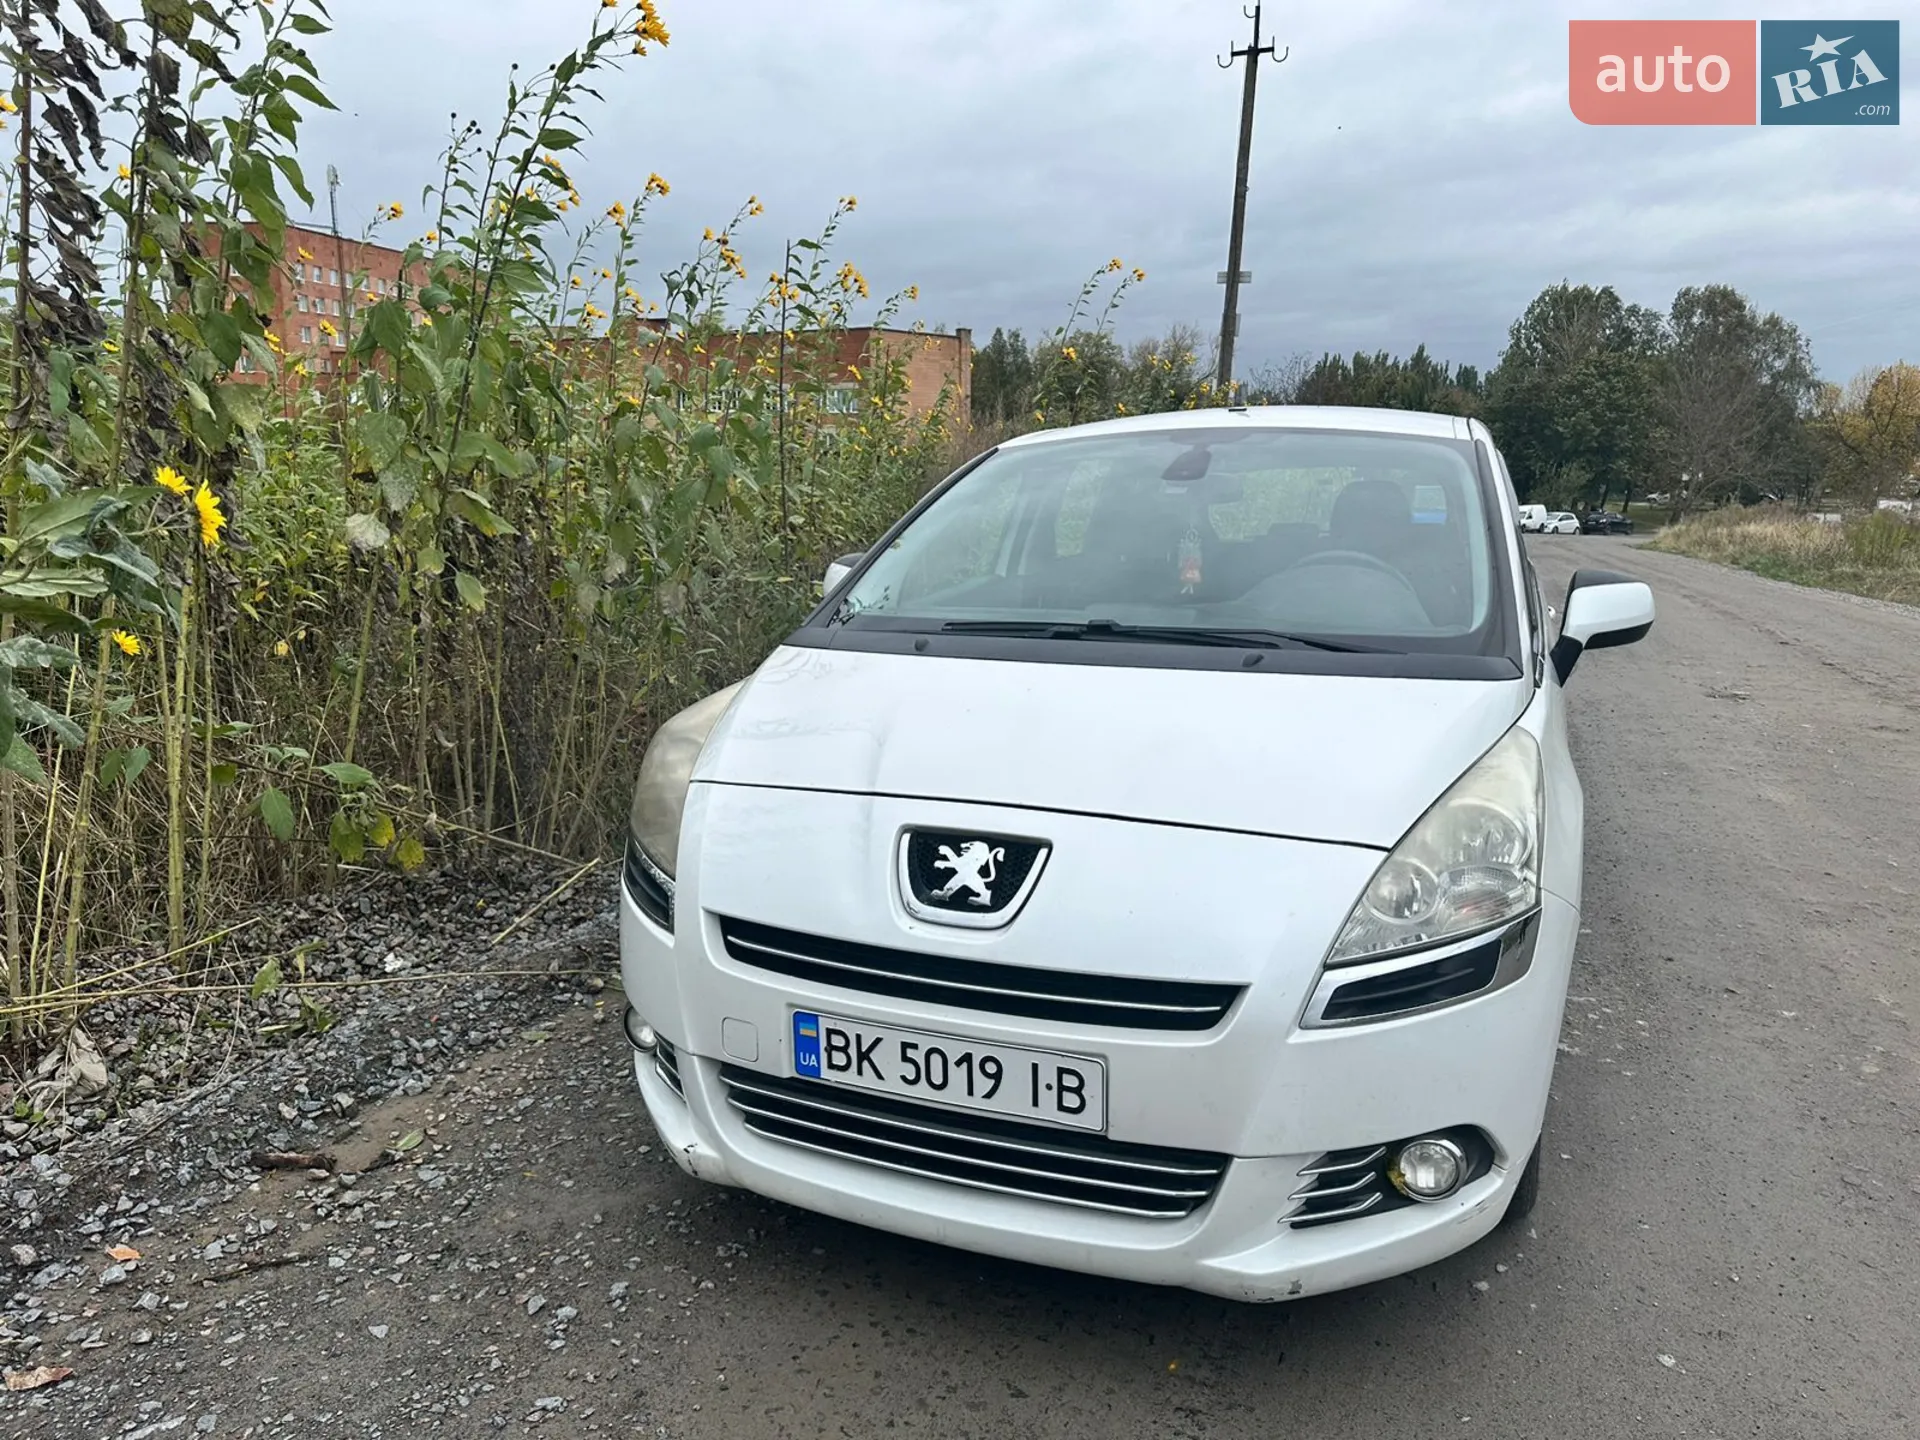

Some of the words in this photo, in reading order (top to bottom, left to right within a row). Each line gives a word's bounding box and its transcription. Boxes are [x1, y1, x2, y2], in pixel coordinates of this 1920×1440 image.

[800, 1050, 818, 1067] UA
[825, 1027, 886, 1081] BK
[899, 1041, 1004, 1099] 5019
